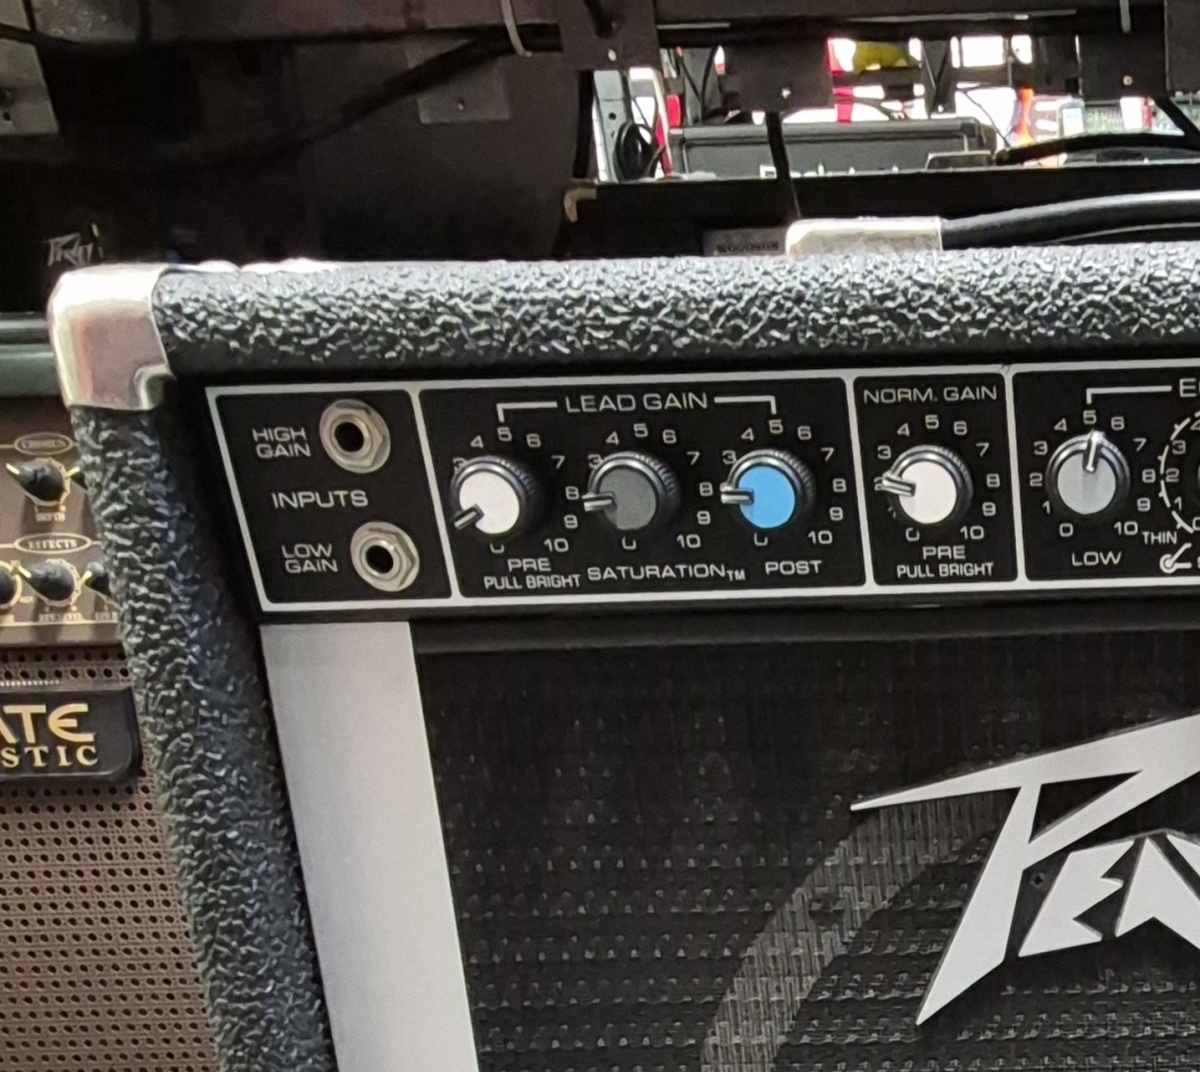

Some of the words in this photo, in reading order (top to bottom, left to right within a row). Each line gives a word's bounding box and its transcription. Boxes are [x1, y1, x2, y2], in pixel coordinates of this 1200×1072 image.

[943, 386, 997, 401] GAIN
[565, 393, 636, 413] LEAD
[643, 392, 708, 411] GAIN
[925, 414, 939, 429] 5
[1083, 410, 1097, 424] 5
[1111, 416, 1125, 430] 6
[634, 423, 648, 437] 5
[768, 419, 783, 434] 5
[897, 423, 910, 436] 4
[953, 421, 968, 435] 6
[1054, 418, 1067, 432] 4
[252, 426, 308, 443] HIGH
[497, 426, 512, 441] 5
[606, 431, 620, 445] 4
[662, 429, 676, 444] 6
[741, 427, 755, 441] 4
[797, 425, 812, 440] 6
[470, 435, 484, 449] 4
[526, 433, 541, 447] 6
[1133, 437, 1147, 451] 7
[1172, 440, 1186, 454] 3
[256, 443, 312, 459] GAIN
[821, 447, 835, 461] 7
[877, 445, 891, 459] 3
[975, 442, 989, 457] 7
[1033, 441, 1048, 455] 3
[552, 455, 565, 469] 7
[588, 454, 602, 468] 3
[686, 451, 700, 466] 7
[722, 450, 737, 464] 3
[986, 473, 1000, 488] 8
[1029, 472, 1043, 487] 2
[1142, 469, 1156, 483] 8
[1165, 468, 1180, 482] 2
[699, 482, 713, 496] 8
[833, 478, 847, 492] 8
[271, 490, 369, 509] INPUTS
[565, 486, 579, 500] 8
[982, 502, 996, 516] 9
[1042, 500, 1051, 514] 1
[1137, 497, 1151, 512] 9
[1174, 497, 1183, 510] 1
[697, 511, 711, 525] 9
[829, 507, 843, 521] 9
[564, 514, 578, 529] 9
[1114, 521, 1138, 536] 10
[960, 525, 985, 540] 10
[1059, 522, 1074, 537] 0
[676, 534, 701, 548] 10
[808, 530, 833, 544] 10
[1142, 531, 1178, 545] THIN
[281, 543, 333, 559] LOW
[544, 538, 569, 552] 10
[922, 545, 966, 560] PRE
[1071, 551, 1122, 566] LOW
[284, 559, 339, 574] GAIN
[507, 557, 552, 572] PRE
[587, 563, 726, 580] SATURATION
[765, 560, 822, 575] POST
[896, 564, 934, 579] PULL
[938, 562, 994, 577] BRIGHT
[484, 575, 523, 590] PULL
[525, 574, 580, 589] BRIGHT
